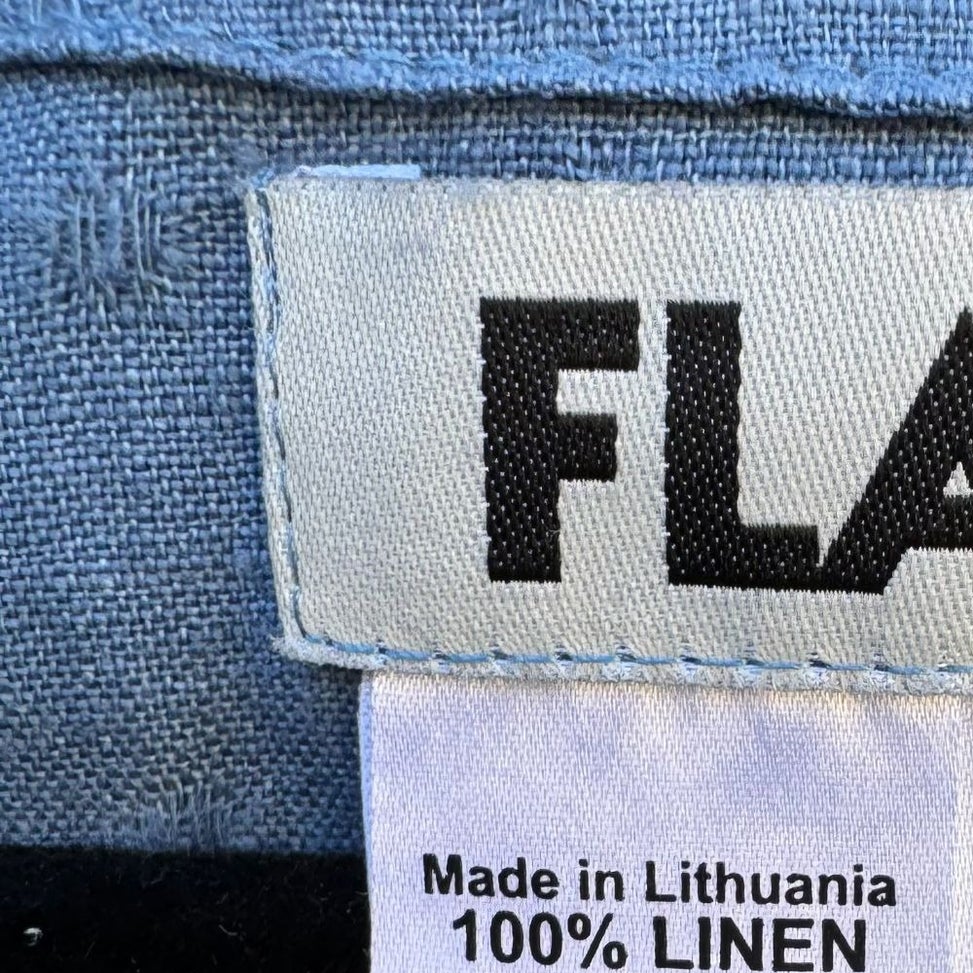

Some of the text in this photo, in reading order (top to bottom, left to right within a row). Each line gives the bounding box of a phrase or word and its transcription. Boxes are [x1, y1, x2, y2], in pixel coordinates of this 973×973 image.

[423, 854, 897, 907] Made in Lithuania
[452, 908, 867, 973] 100% LINEN
